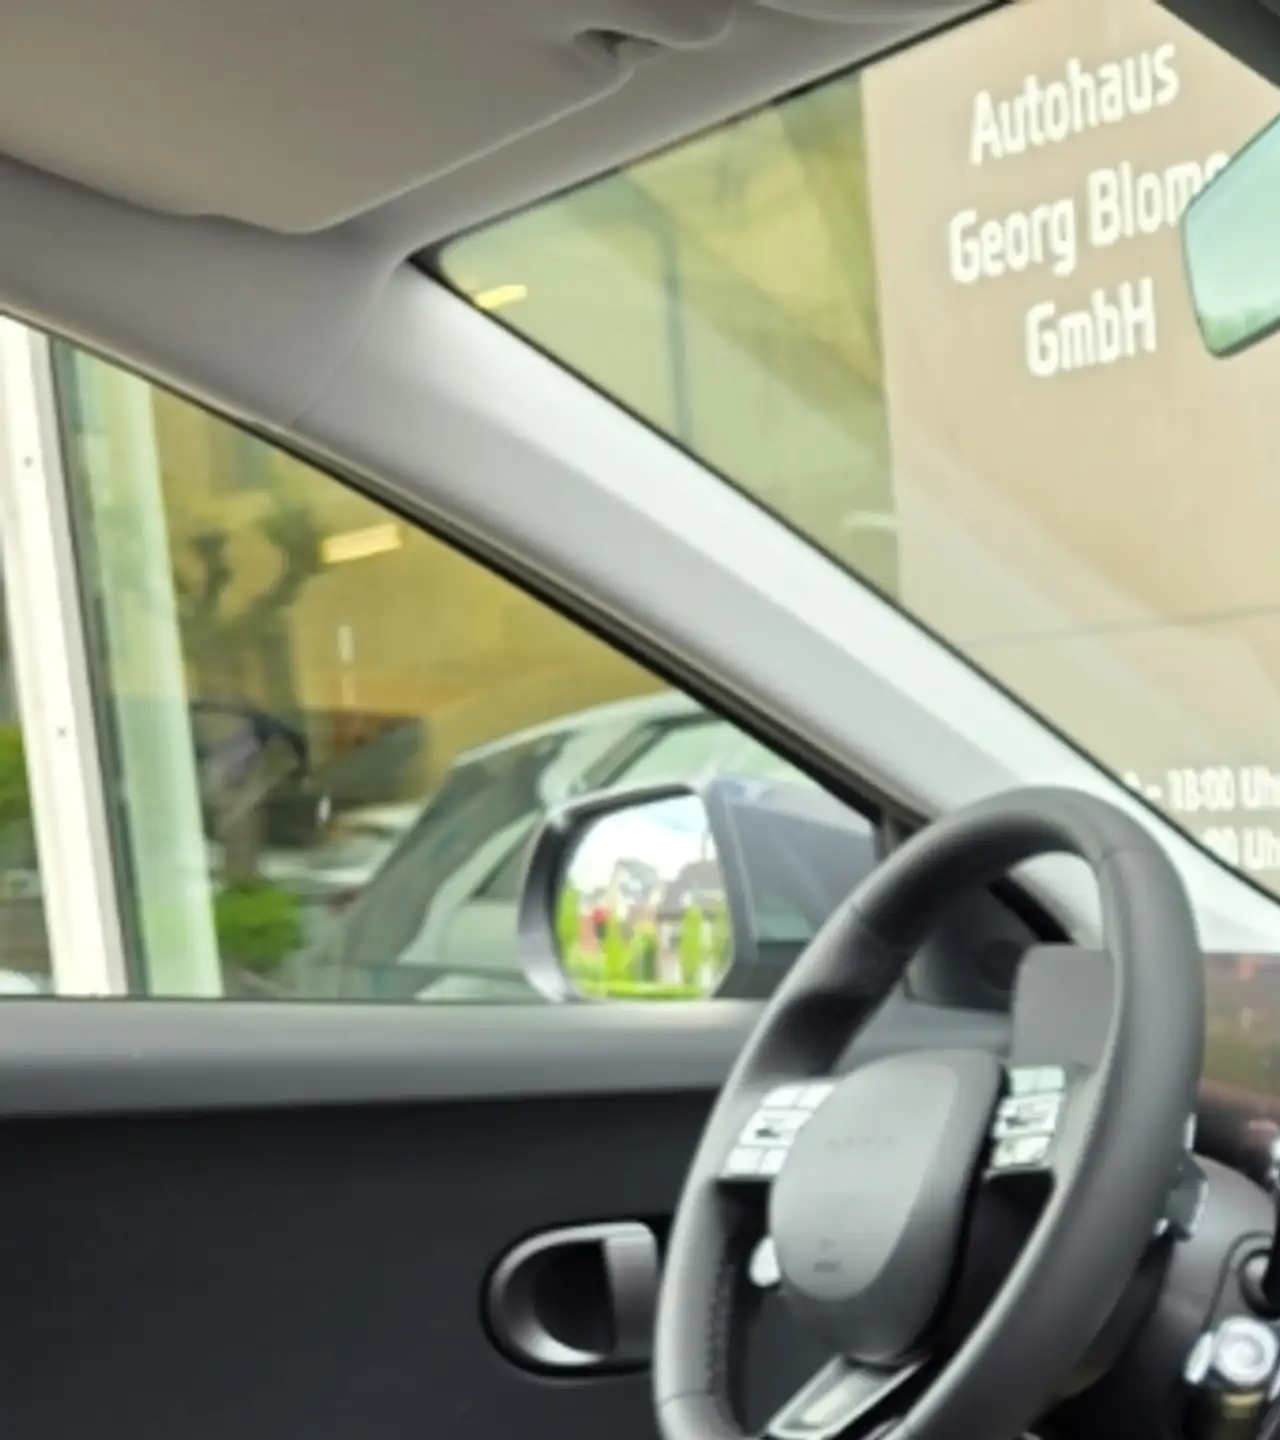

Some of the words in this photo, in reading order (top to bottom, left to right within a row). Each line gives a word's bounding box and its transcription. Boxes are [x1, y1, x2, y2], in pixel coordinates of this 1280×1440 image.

[969, 42, 1180, 167] Autohaus
[949, 196, 1078, 284] Georg
[1025, 275, 1157, 378] GmbH
